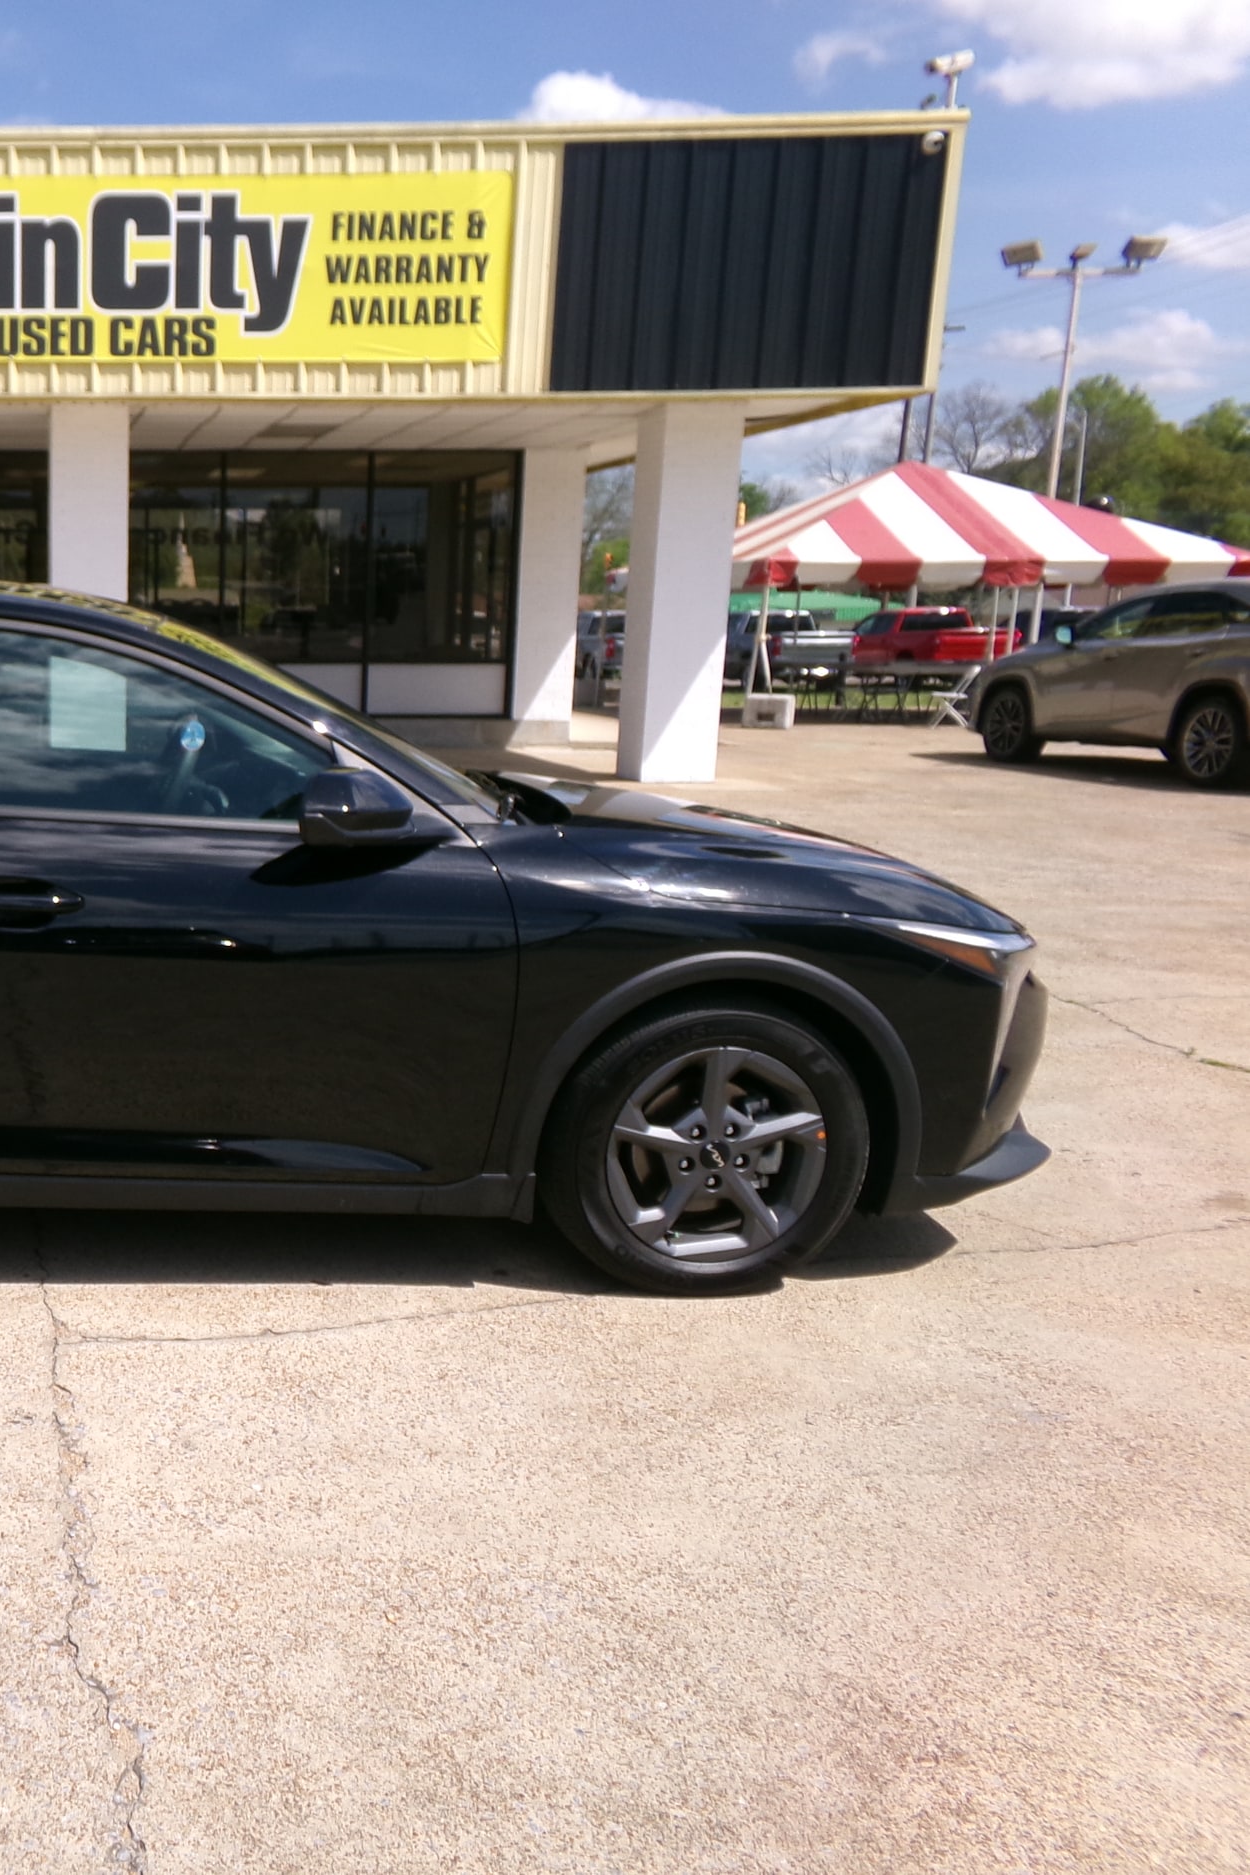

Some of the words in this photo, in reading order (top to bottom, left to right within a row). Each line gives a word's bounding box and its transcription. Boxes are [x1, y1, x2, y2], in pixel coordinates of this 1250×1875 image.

[331, 210, 454, 241] FINANCE
[466, 210, 486, 240] &
[325, 253, 489, 284] WARRANTY
[329, 296, 483, 325] AVAILABLE
[109, 317, 216, 357] CARS
